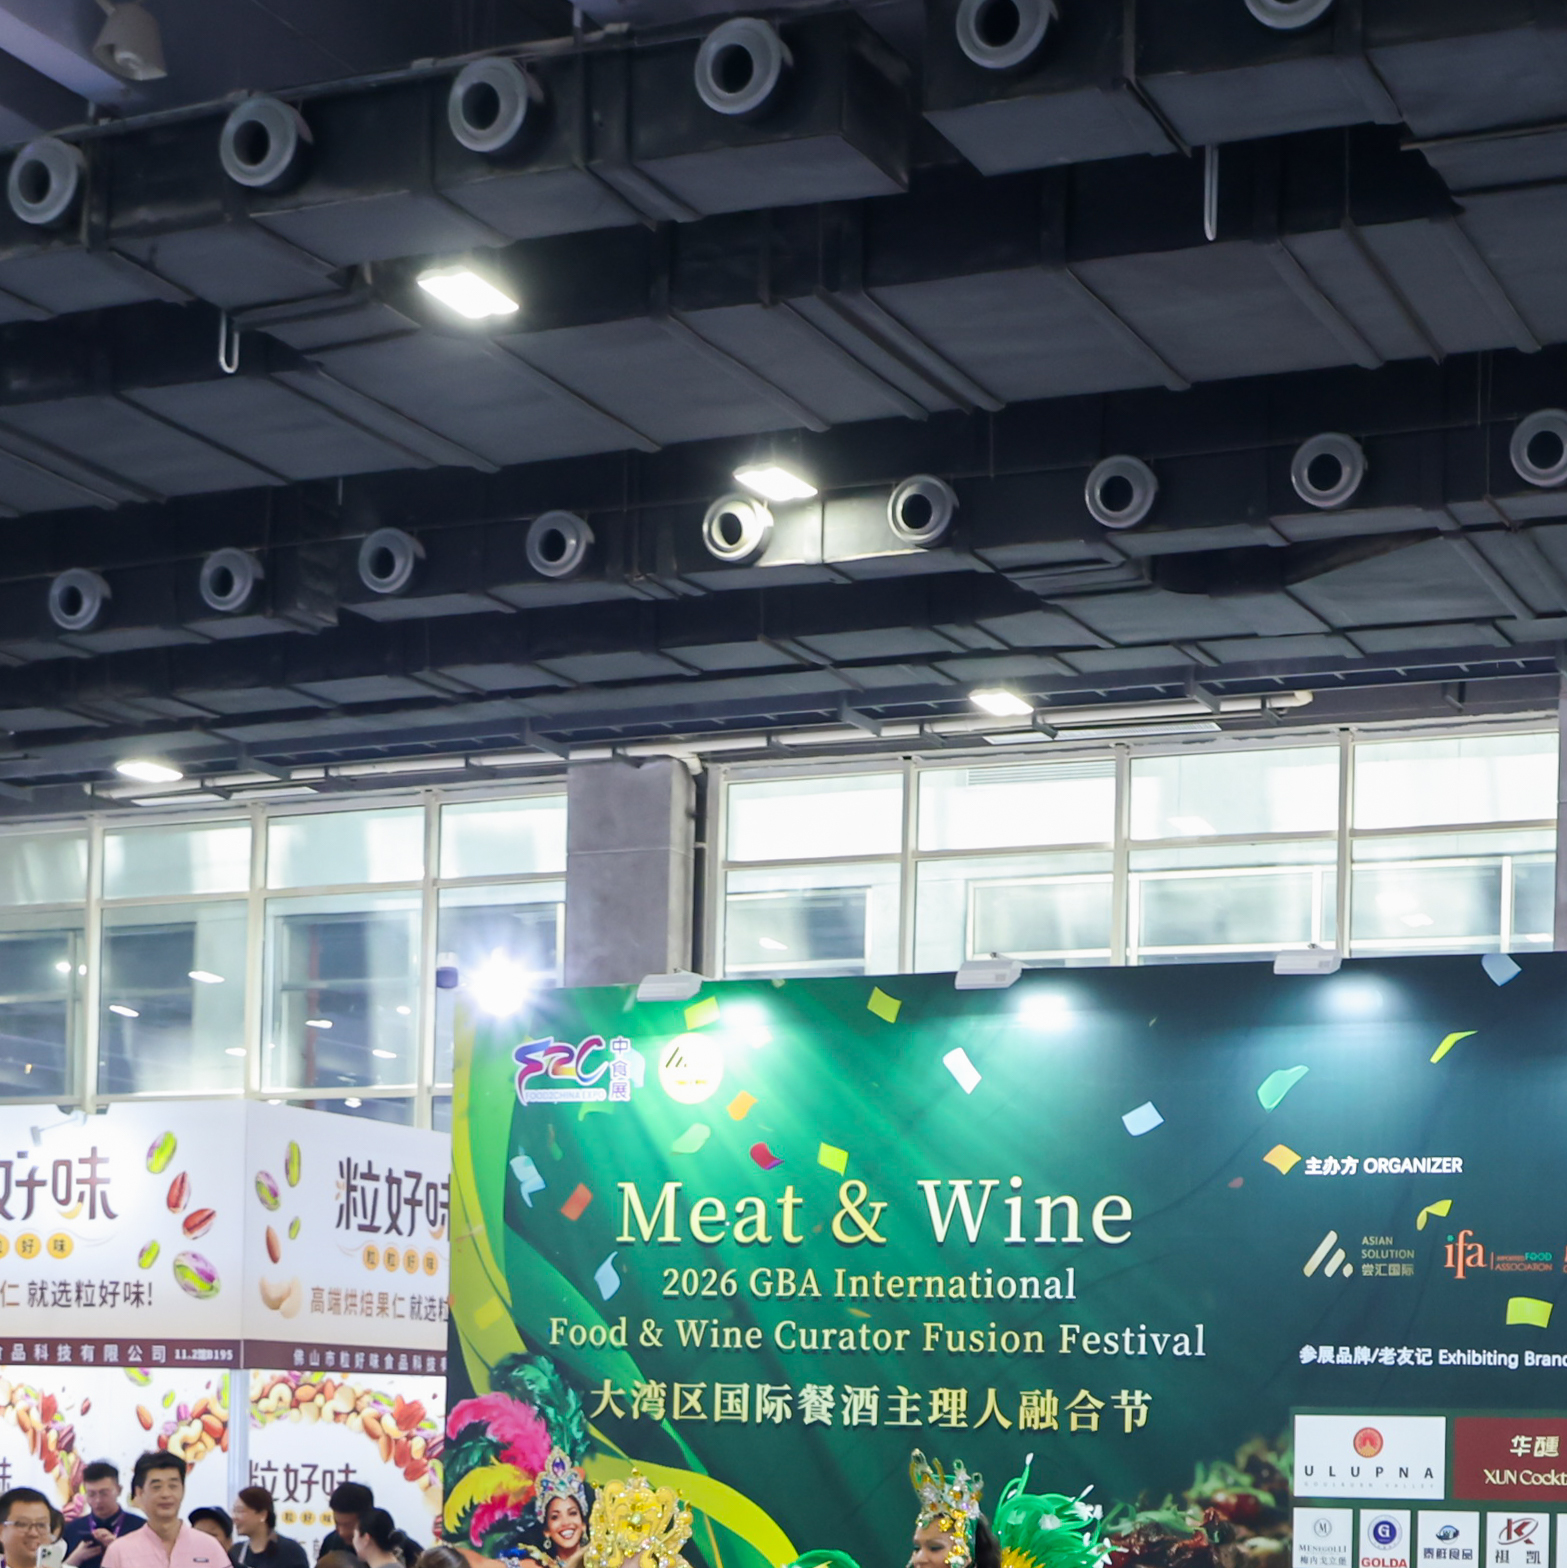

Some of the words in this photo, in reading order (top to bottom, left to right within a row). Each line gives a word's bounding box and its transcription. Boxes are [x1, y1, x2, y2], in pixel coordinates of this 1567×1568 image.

[611, 1037, 629, 1100] 中食展
[1305, 1156, 1359, 1175] 主办方
[1363, 1157, 1463, 1174] ORGANIZER
[616, 1181, 804, 1244] Meat
[832, 1179, 888, 1244] &
[917, 1175, 1132, 1244] Wine
[1362, 1236, 1393, 1246] ASIAN
[1362, 1249, 1415, 1259] SOLUTION
[1444, 1230, 1487, 1279] ifa
[1525, 1253, 1552, 1262] FOOD
[28, 1280, 152, 1309] 就选粒好味!
[662, 1268, 737, 1297] 2026
[749, 1267, 822, 1298] GBA
[834, 1267, 1076, 1300] International
[311, 1287, 405, 1319] 高端烘焙果仁
[549, 1316, 628, 1347] Food
[639, 1318, 663, 1348] &
[675, 1319, 763, 1349] Wine
[774, 1320, 910, 1352] Curator
[923, 1322, 1044, 1353] Fusion
[1059, 1323, 1206, 1356] Festival
[1299, 1345, 1433, 1366] 参展品牌/老友记
[1438, 1348, 1519, 1370] Exhibiting
[589, 1378, 1152, 1434] 大湾区国际餐酒主理人融合节
[1483, 1469, 1517, 1485] XUN
[1361, 1557, 1408, 1568] GOLDA
